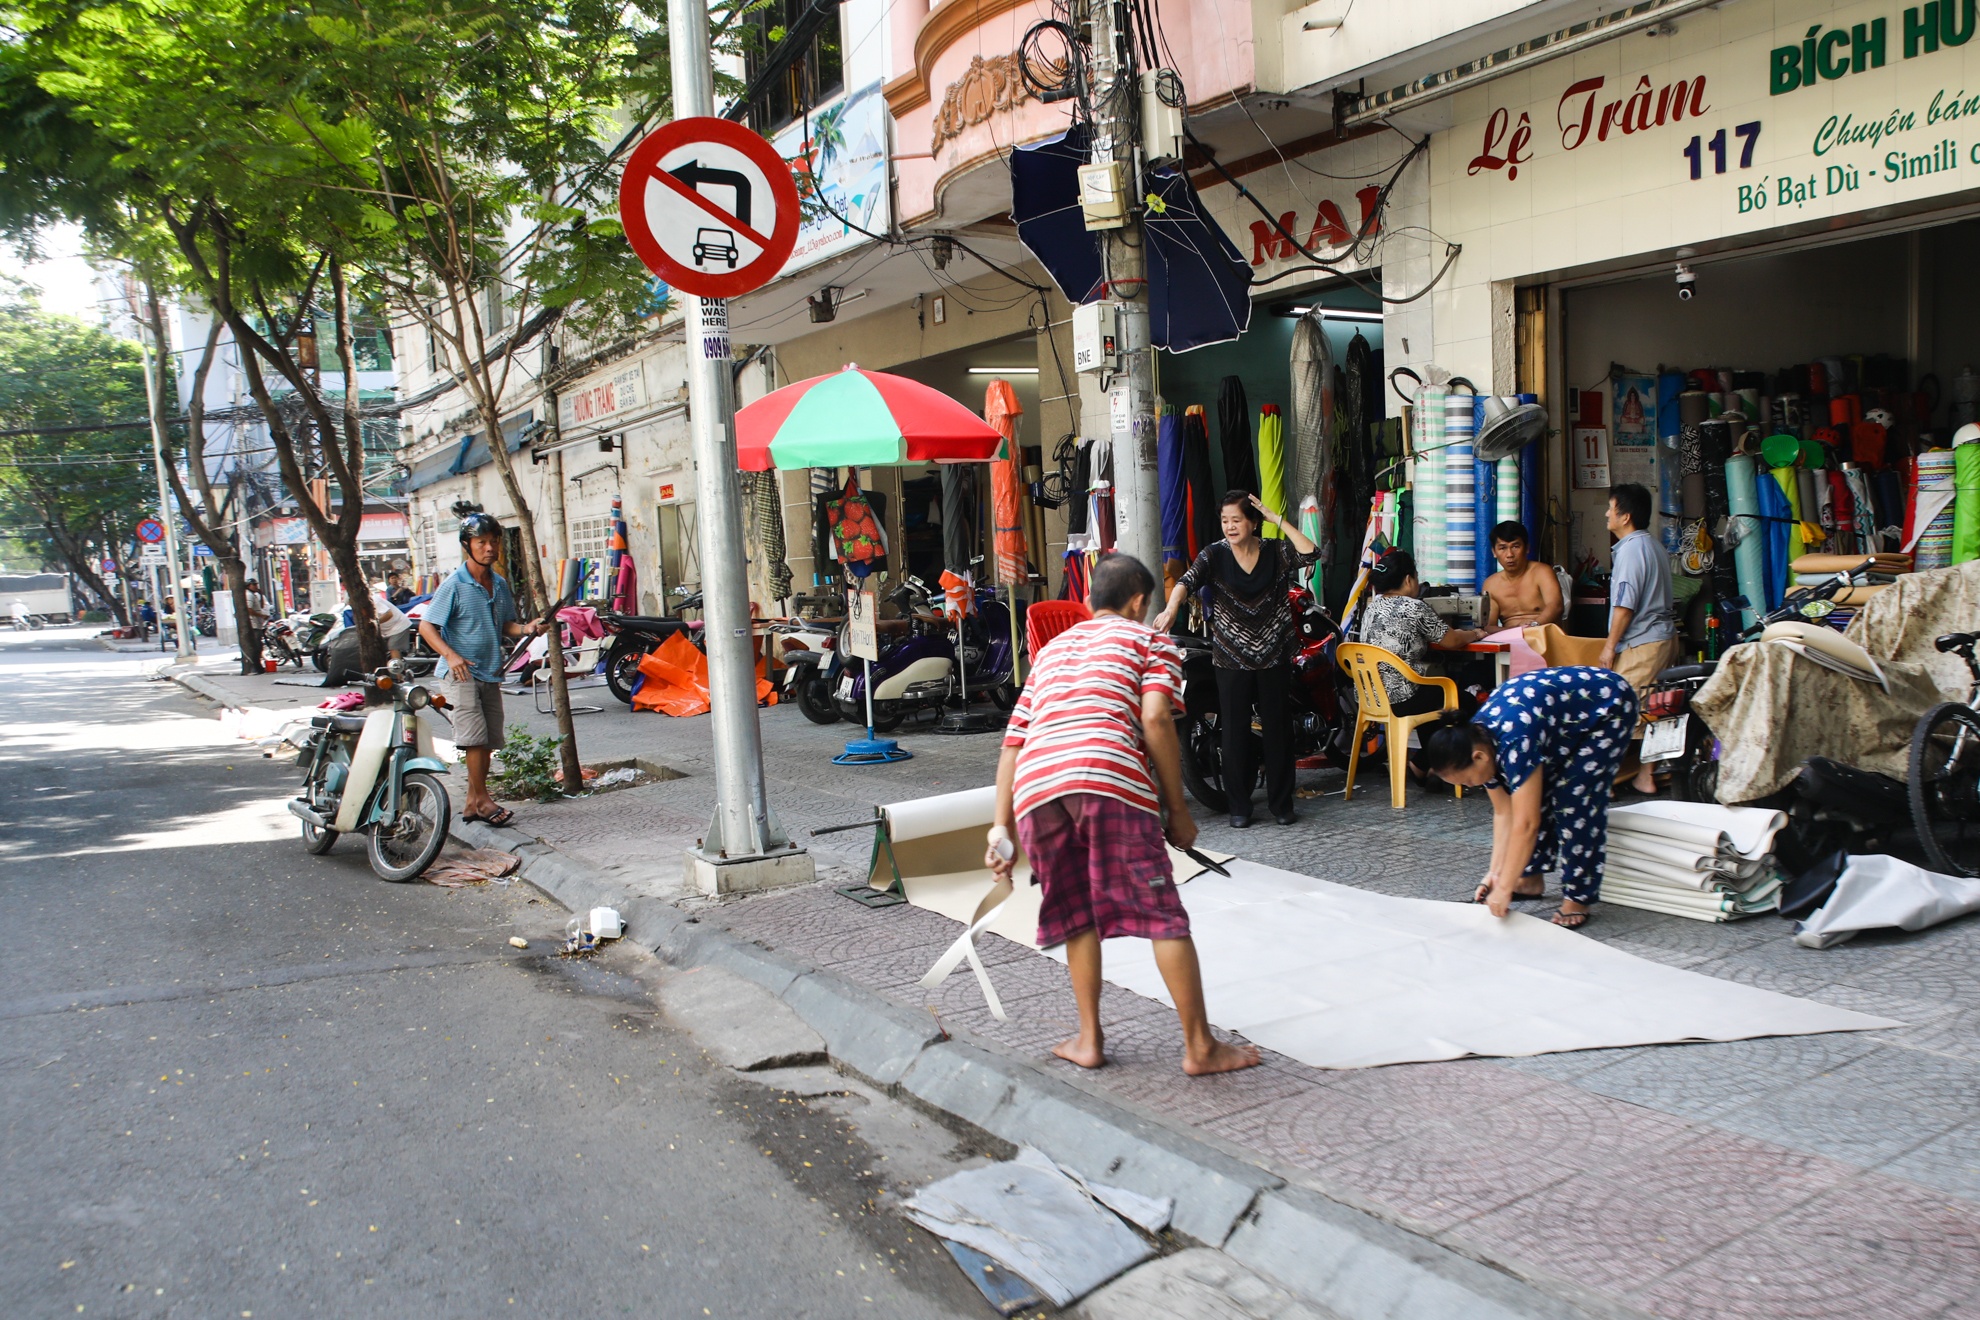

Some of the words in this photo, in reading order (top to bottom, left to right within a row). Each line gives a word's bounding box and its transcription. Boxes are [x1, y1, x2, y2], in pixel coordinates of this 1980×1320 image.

[1769, 17, 1886, 96] BÍCH
[1466, 107, 1535, 182] Lệ
[1557, 74, 1711, 151] Trâm
[1683, 120, 1762, 181] 117
[1812, 109, 1918, 157] Chuyên
[1927, 88, 1980, 128] bán
[1737, 176, 1768, 215] Bố
[1777, 171, 1817, 210] Bạt
[1826, 161, 1860, 198] Dù
[1884, 138, 1958, 183] Simili
[1249, 186, 1382, 266] MAI
[701, 297, 725, 306] BNE
[702, 307, 726, 316] WAS
[702, 318, 727, 327] HERE
[1078, 349, 1091, 365] BNE
[1583, 436, 1599, 459] 11
